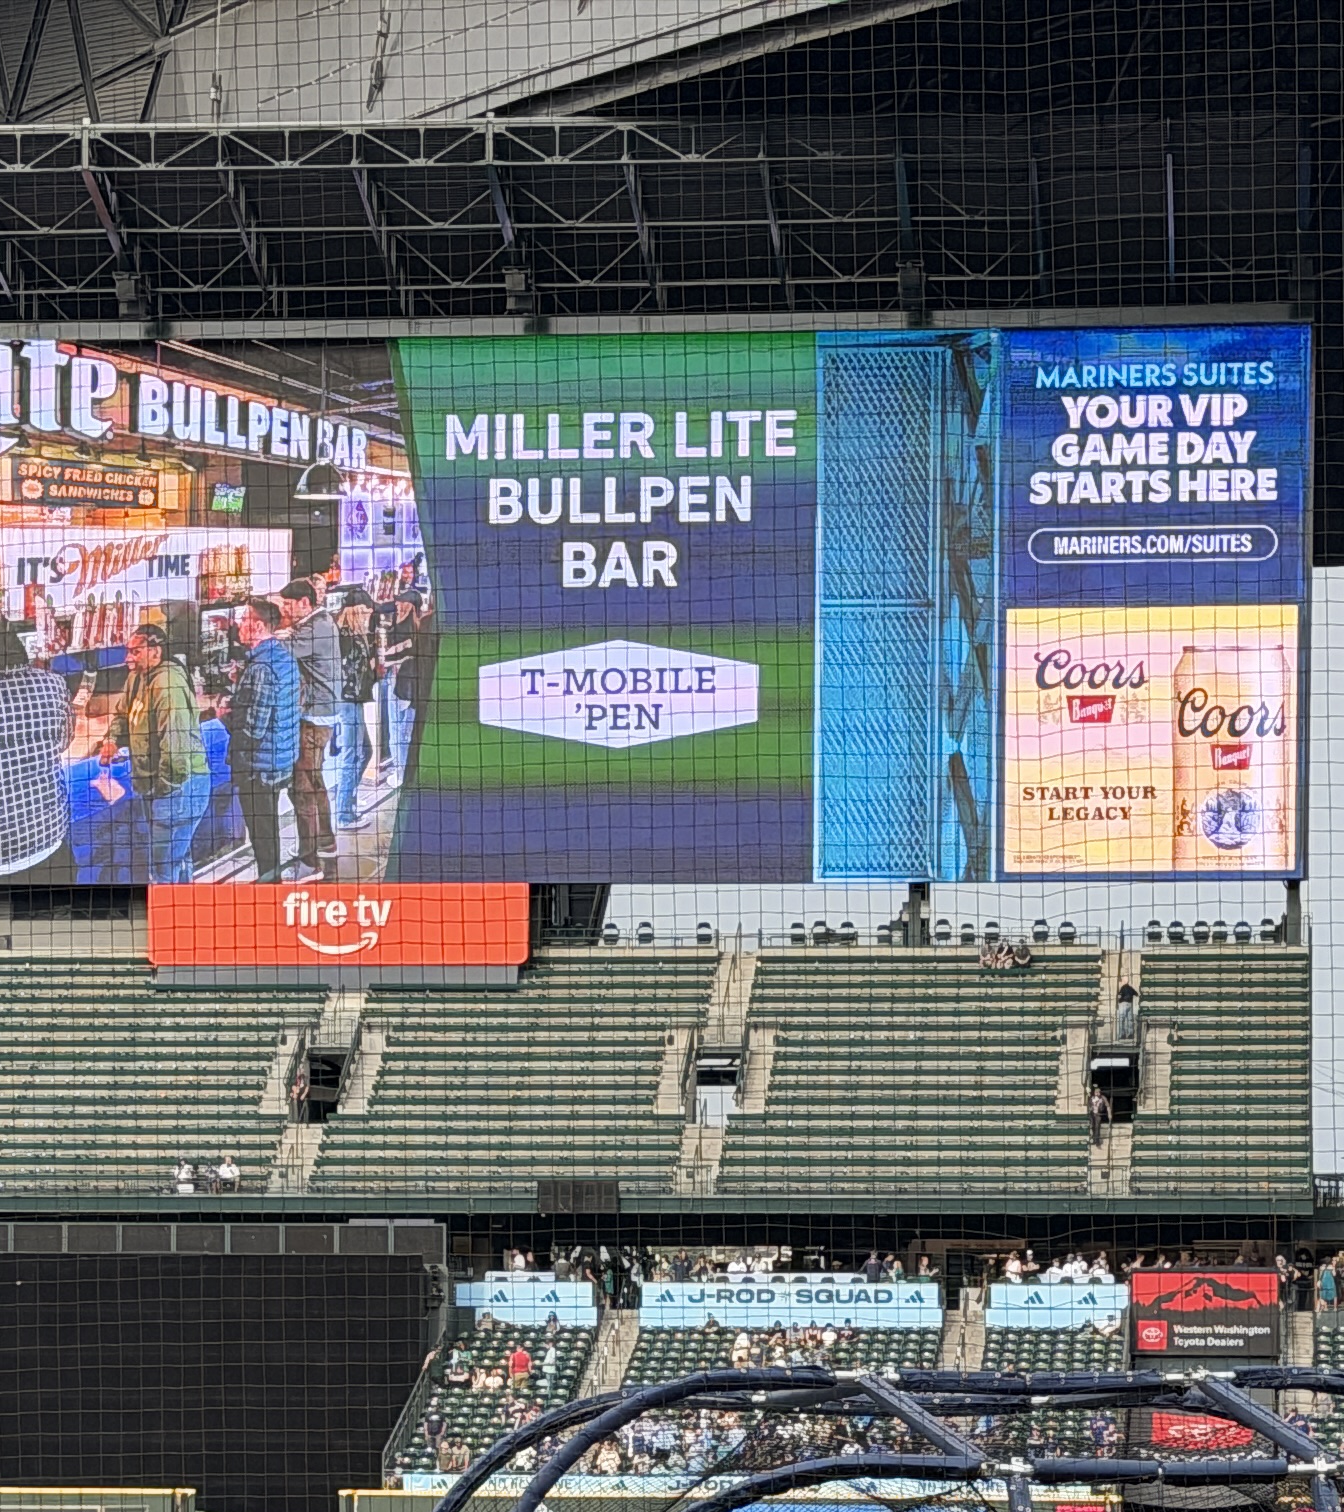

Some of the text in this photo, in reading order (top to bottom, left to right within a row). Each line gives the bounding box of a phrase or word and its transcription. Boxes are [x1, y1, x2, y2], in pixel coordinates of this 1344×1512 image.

[1036, 361, 1275, 390] MARINERS SUITES
[138, 374, 310, 465] BULLPEN
[318, 416, 367, 469] BAR
[1062, 393, 1248, 429] YOUR VIP
[445, 409, 798, 461] MILLER LITE
[1052, 431, 1257, 467] GAME DAY
[18, 463, 158, 488] SPICY FRIED CHICKEN
[1029, 468, 1278, 505] STARTS HERE
[48, 484, 134, 502] SANDWICHES
[488, 475, 751, 524] BULLPEN
[1053, 534, 1253, 556] MARINERS.COM/SUITES
[147, 554, 191, 578] TIME
[562, 541, 678, 589] BAR
[520, 666, 717, 696] T-MOBILE
[1034, 649, 1148, 691] Coors
[575, 702, 663, 732] 'PEN
[1070, 698, 1116, 721] Banquet
[1177, 688, 1286, 739] Coors
[1022, 785, 1158, 803] START YOUR
[1047, 804, 1133, 823] LEGACY
[282, 892, 392, 928] fire tv
[688, 1288, 894, 1304] J-ROD SQUAD
[1173, 1323, 1270, 1338] Western Washington
[1173, 1336, 1244, 1348] Toyota Dealers
